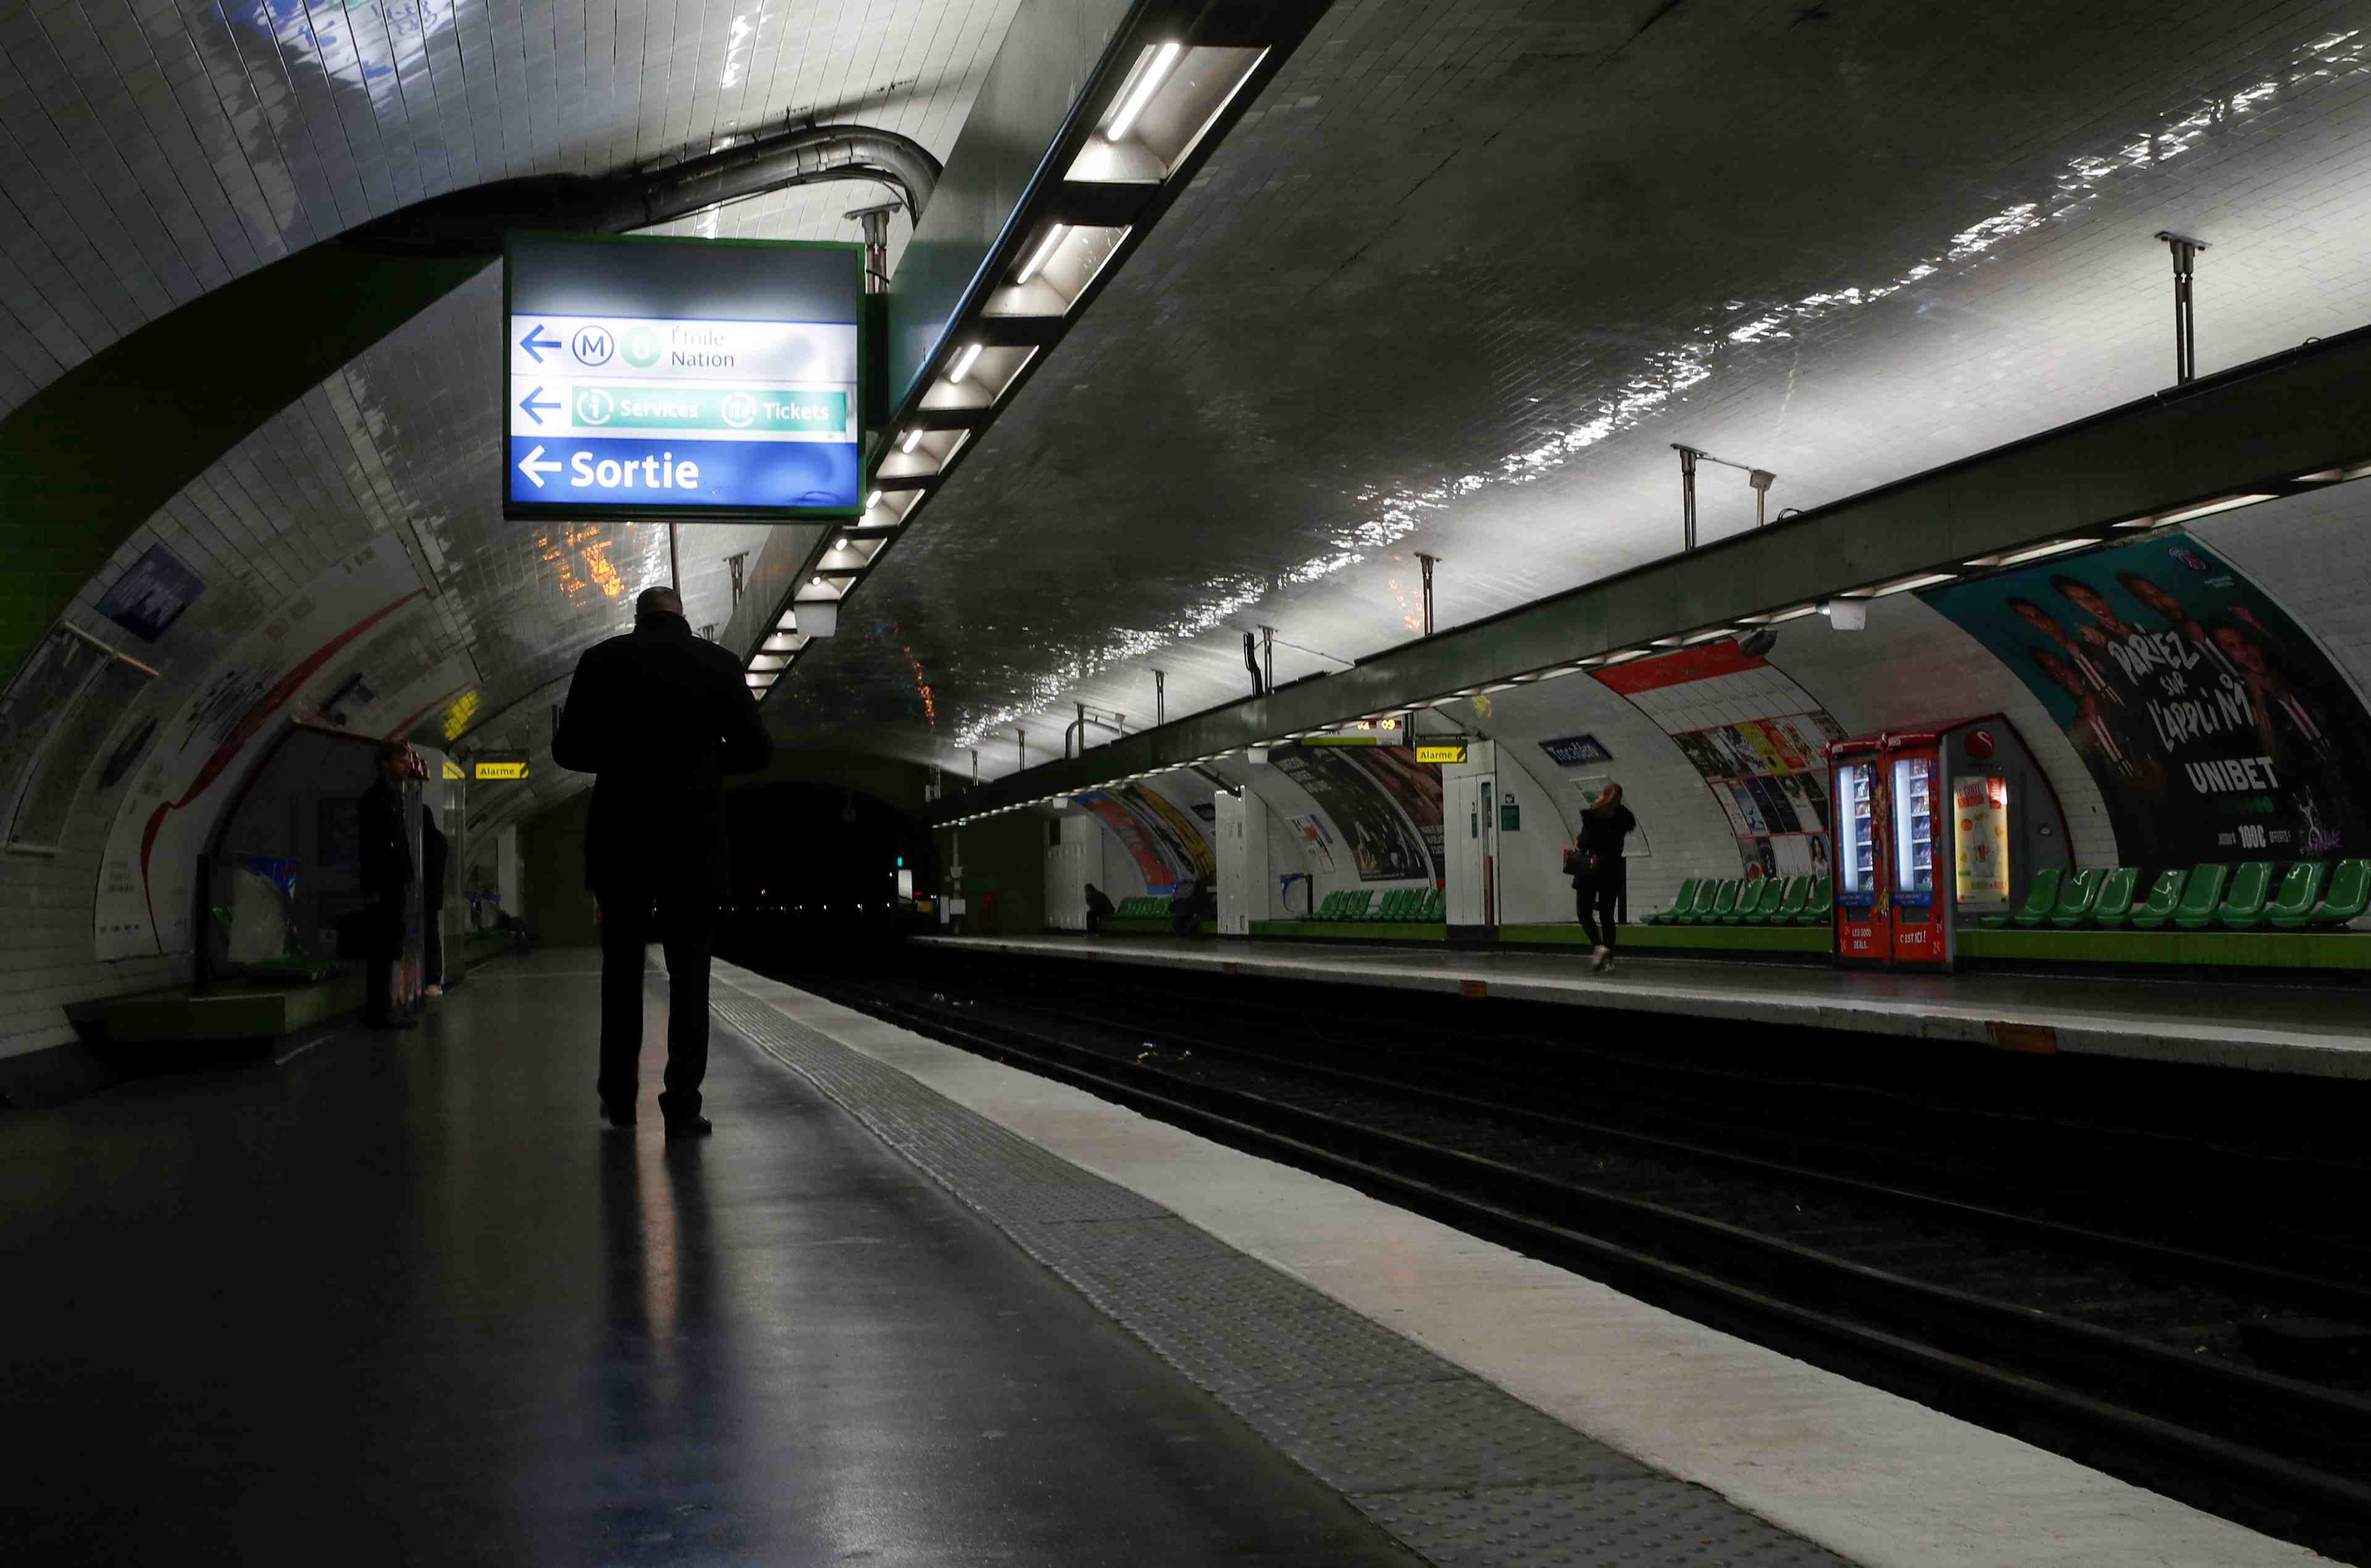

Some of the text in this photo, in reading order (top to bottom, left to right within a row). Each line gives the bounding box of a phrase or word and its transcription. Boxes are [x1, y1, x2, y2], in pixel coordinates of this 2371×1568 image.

[671, 351, 735, 369] Nation
[621, 398, 699, 419] Services
[762, 401, 829, 421] Tickets
[571, 451, 700, 489] Sortie
[2160, 671, 2188, 696] SUR
[1421, 749, 1452, 759] Alarme
[481, 768, 514, 776] Alarme
[2184, 756, 2279, 794] UNIBET
